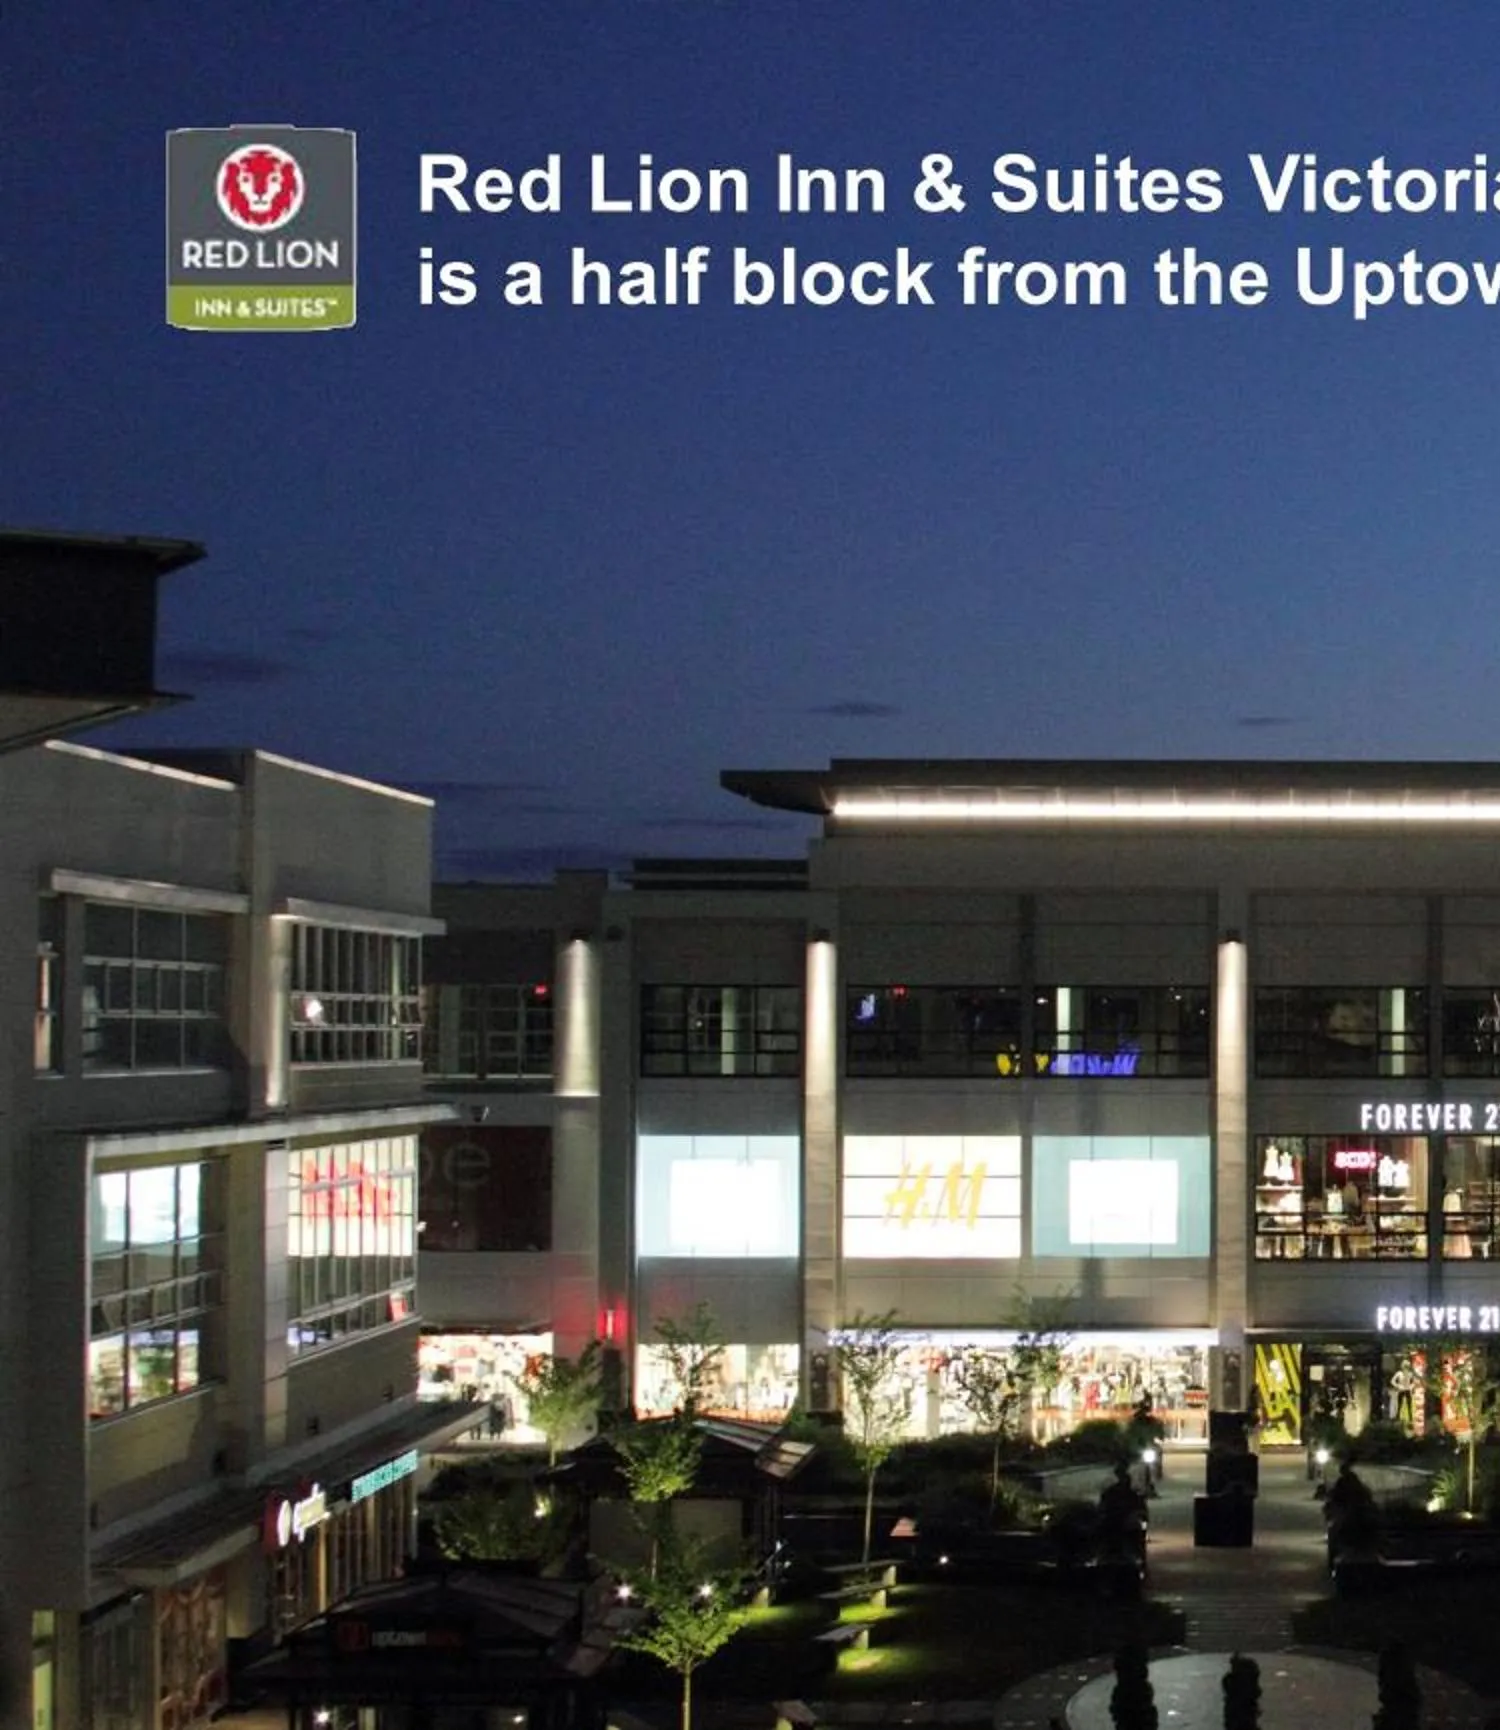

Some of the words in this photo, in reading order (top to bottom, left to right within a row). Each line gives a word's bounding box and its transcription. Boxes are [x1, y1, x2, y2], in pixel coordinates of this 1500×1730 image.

[1360, 1103, 1473, 1131] FOREVER
[1376, 1305, 1473, 1331] FOREVER
[1478, 1305, 1500, 1331] 21
